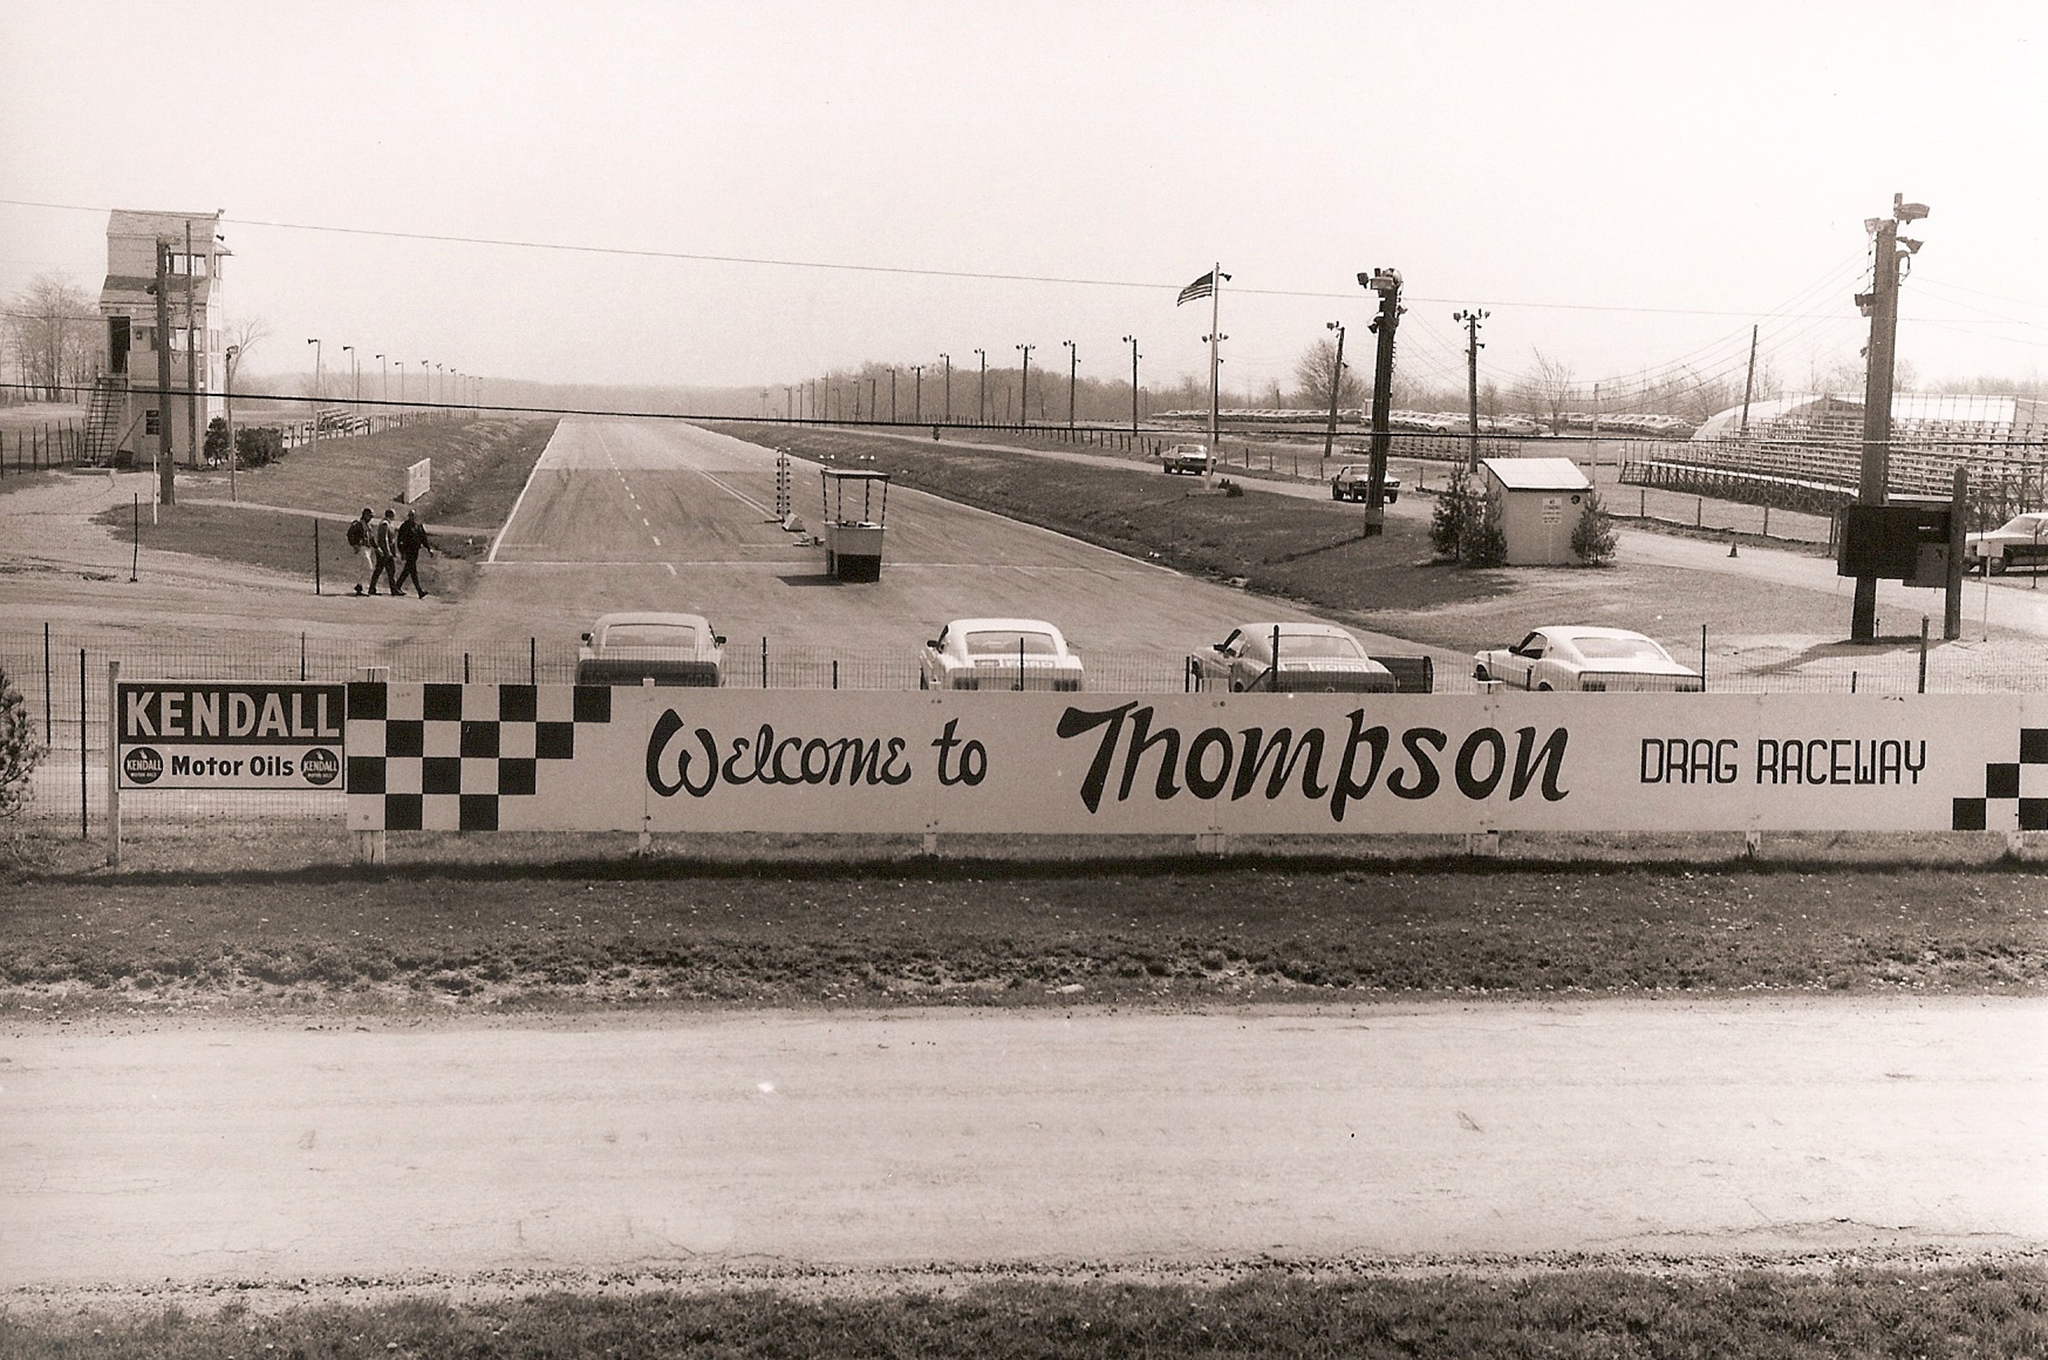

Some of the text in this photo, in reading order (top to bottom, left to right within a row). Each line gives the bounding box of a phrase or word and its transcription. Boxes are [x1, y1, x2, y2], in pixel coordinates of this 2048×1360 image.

[126, 691, 340, 738] KENDALL
[127, 760, 162, 771] KENDALL
[171, 755, 294, 776] Motor Oils
[303, 760, 338, 772] KENDALL
[646, 700, 1927, 822] Welcome to Thompson DRAG RACEWAY
